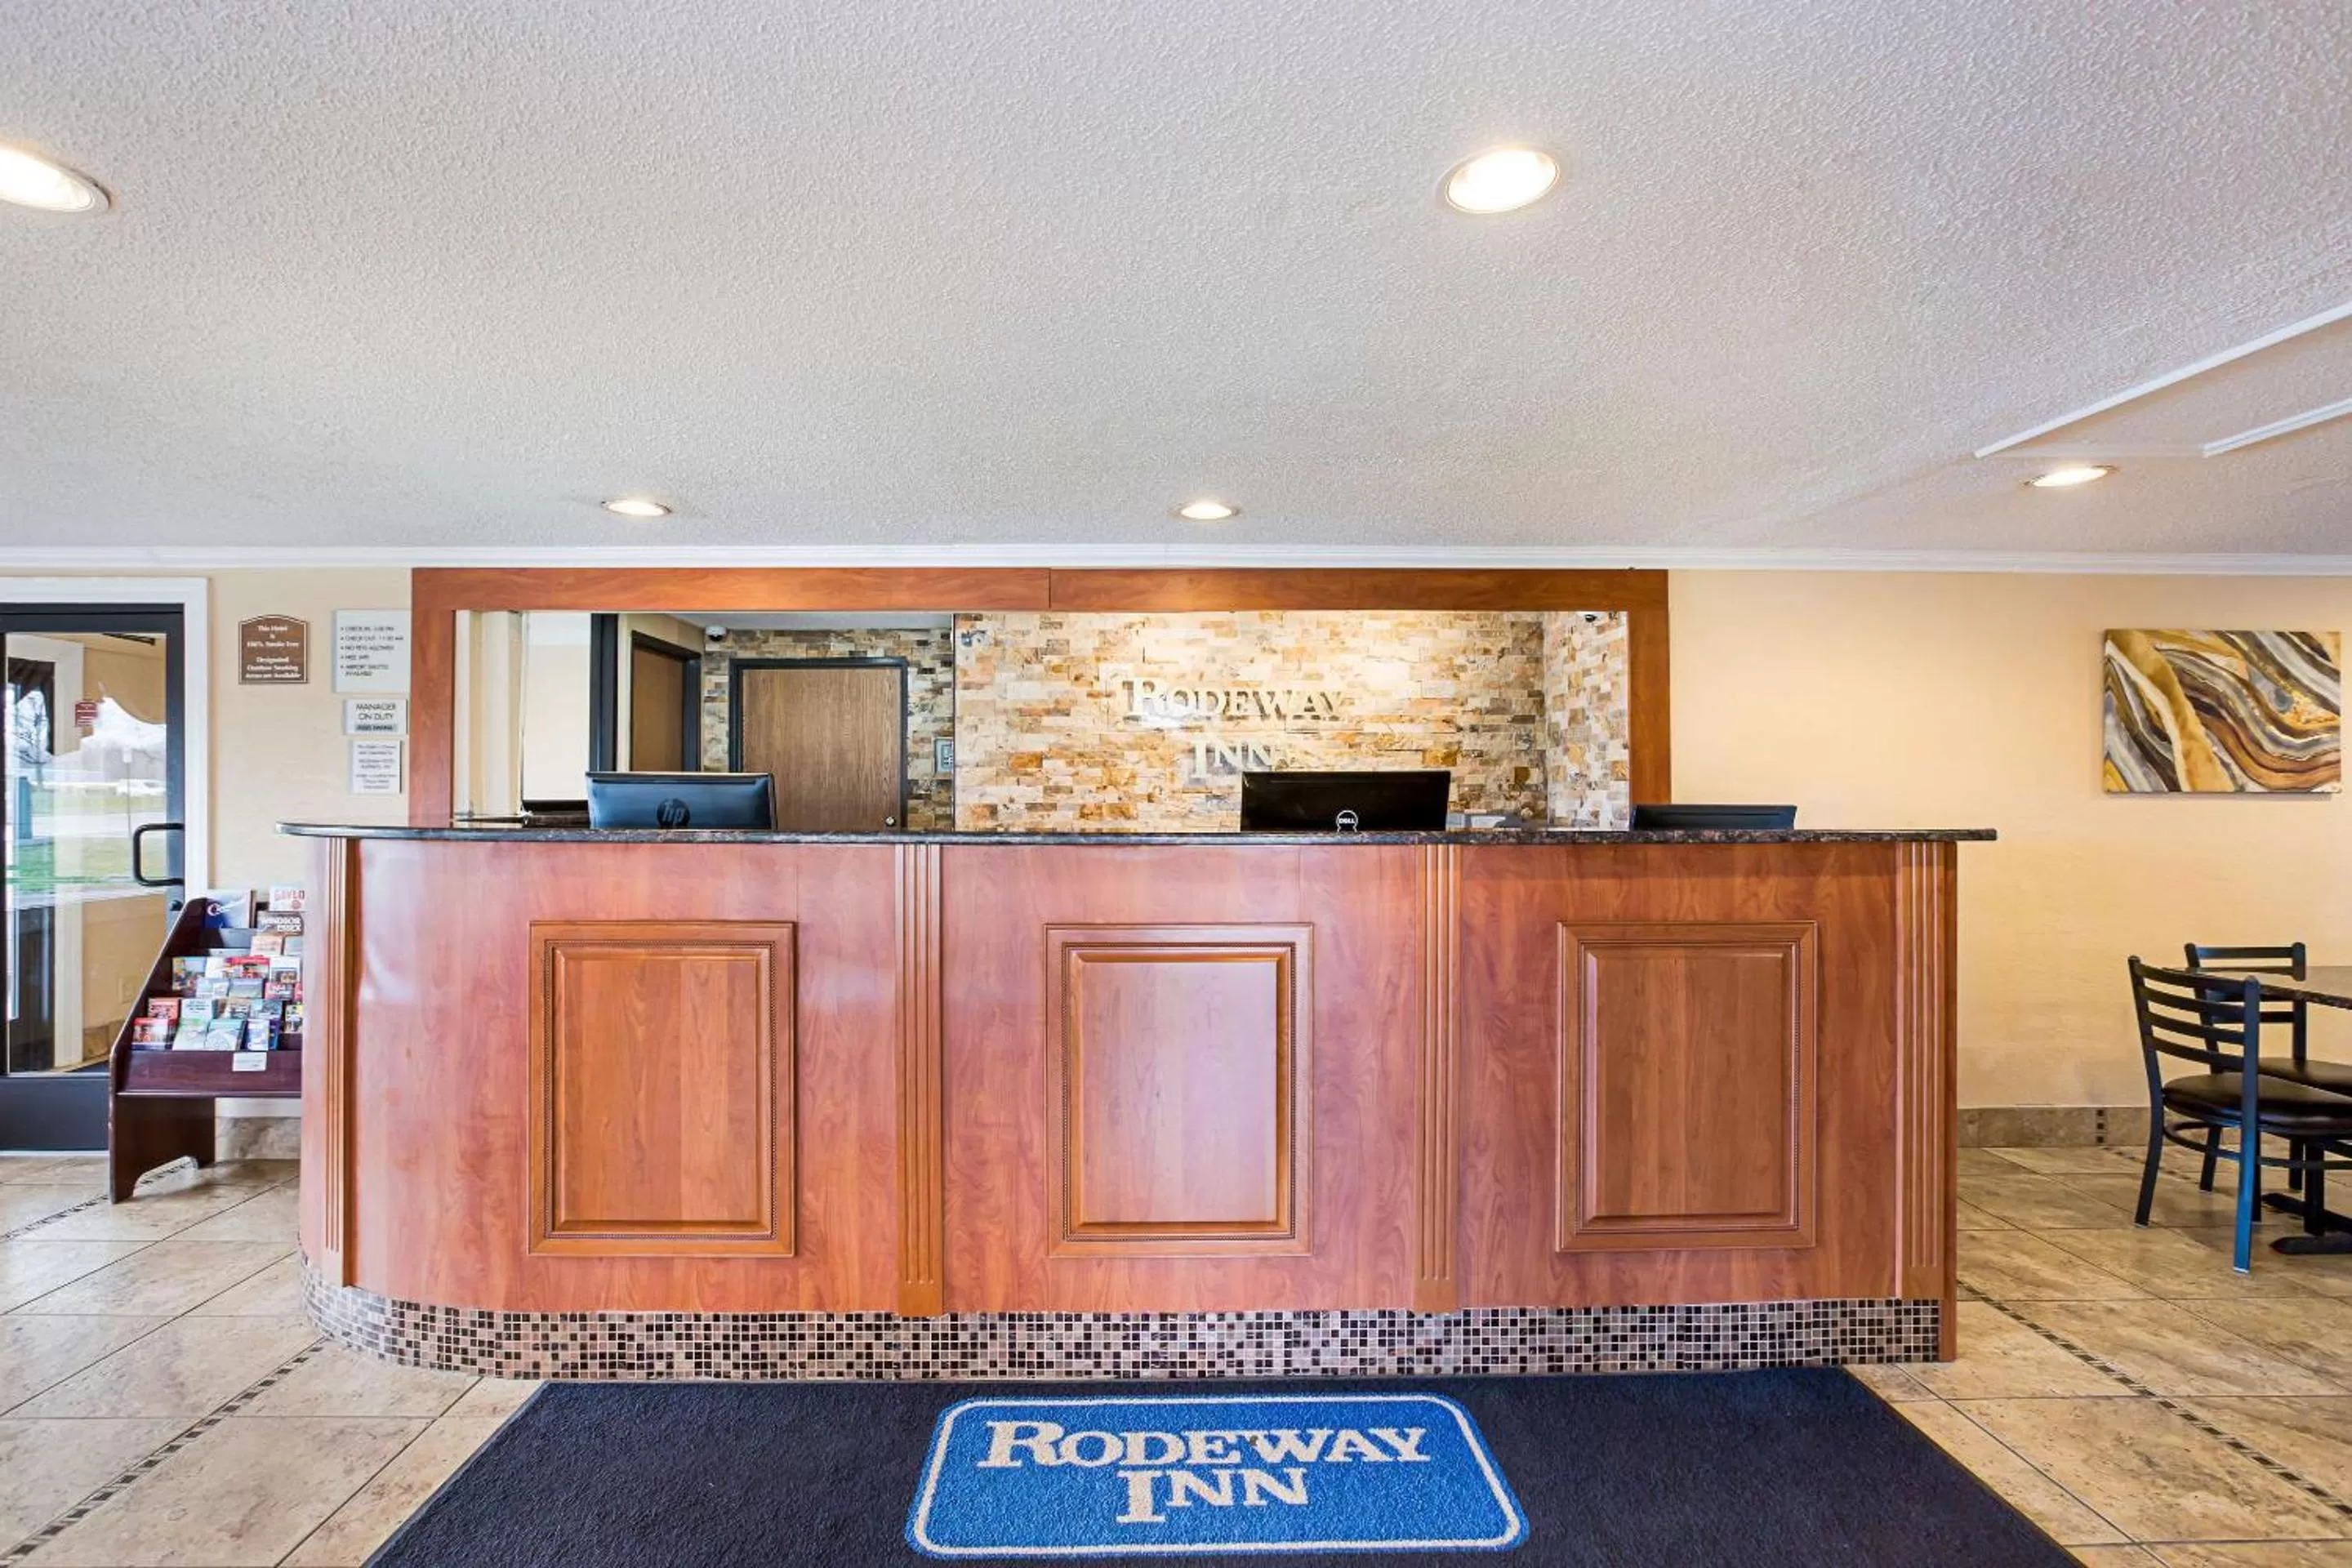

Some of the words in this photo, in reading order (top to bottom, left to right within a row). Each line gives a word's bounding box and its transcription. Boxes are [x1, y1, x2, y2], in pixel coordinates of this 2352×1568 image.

[356, 702, 396, 711] MANAGER
[358, 712, 372, 720] ON
[374, 712, 394, 720] DUTY
[1122, 677, 1346, 722] RODEWAY
[1188, 735, 1280, 781] INN
[662, 799, 685, 828] hp
[976, 1419, 1431, 1468] RODEWAY
[1116, 1467, 1308, 1524] INN
